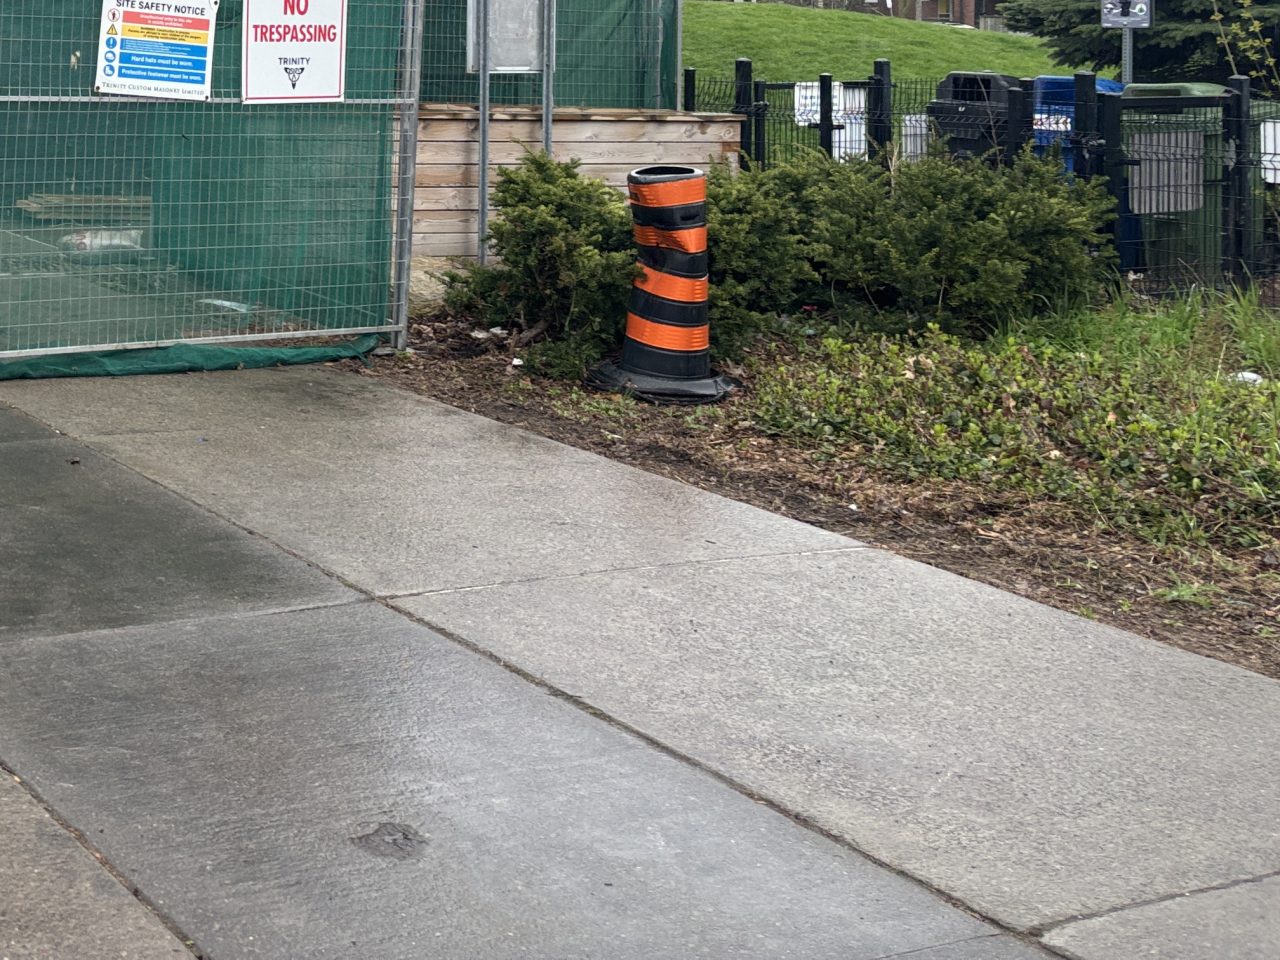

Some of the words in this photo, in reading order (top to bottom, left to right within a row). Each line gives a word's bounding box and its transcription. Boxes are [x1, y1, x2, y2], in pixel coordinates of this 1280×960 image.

[138, 0, 172, 12] SAFETY
[174, 5, 206, 16] NOTICE
[252, 23, 337, 43] TRESPASSING
[278, 56, 310, 66] TRINITY
